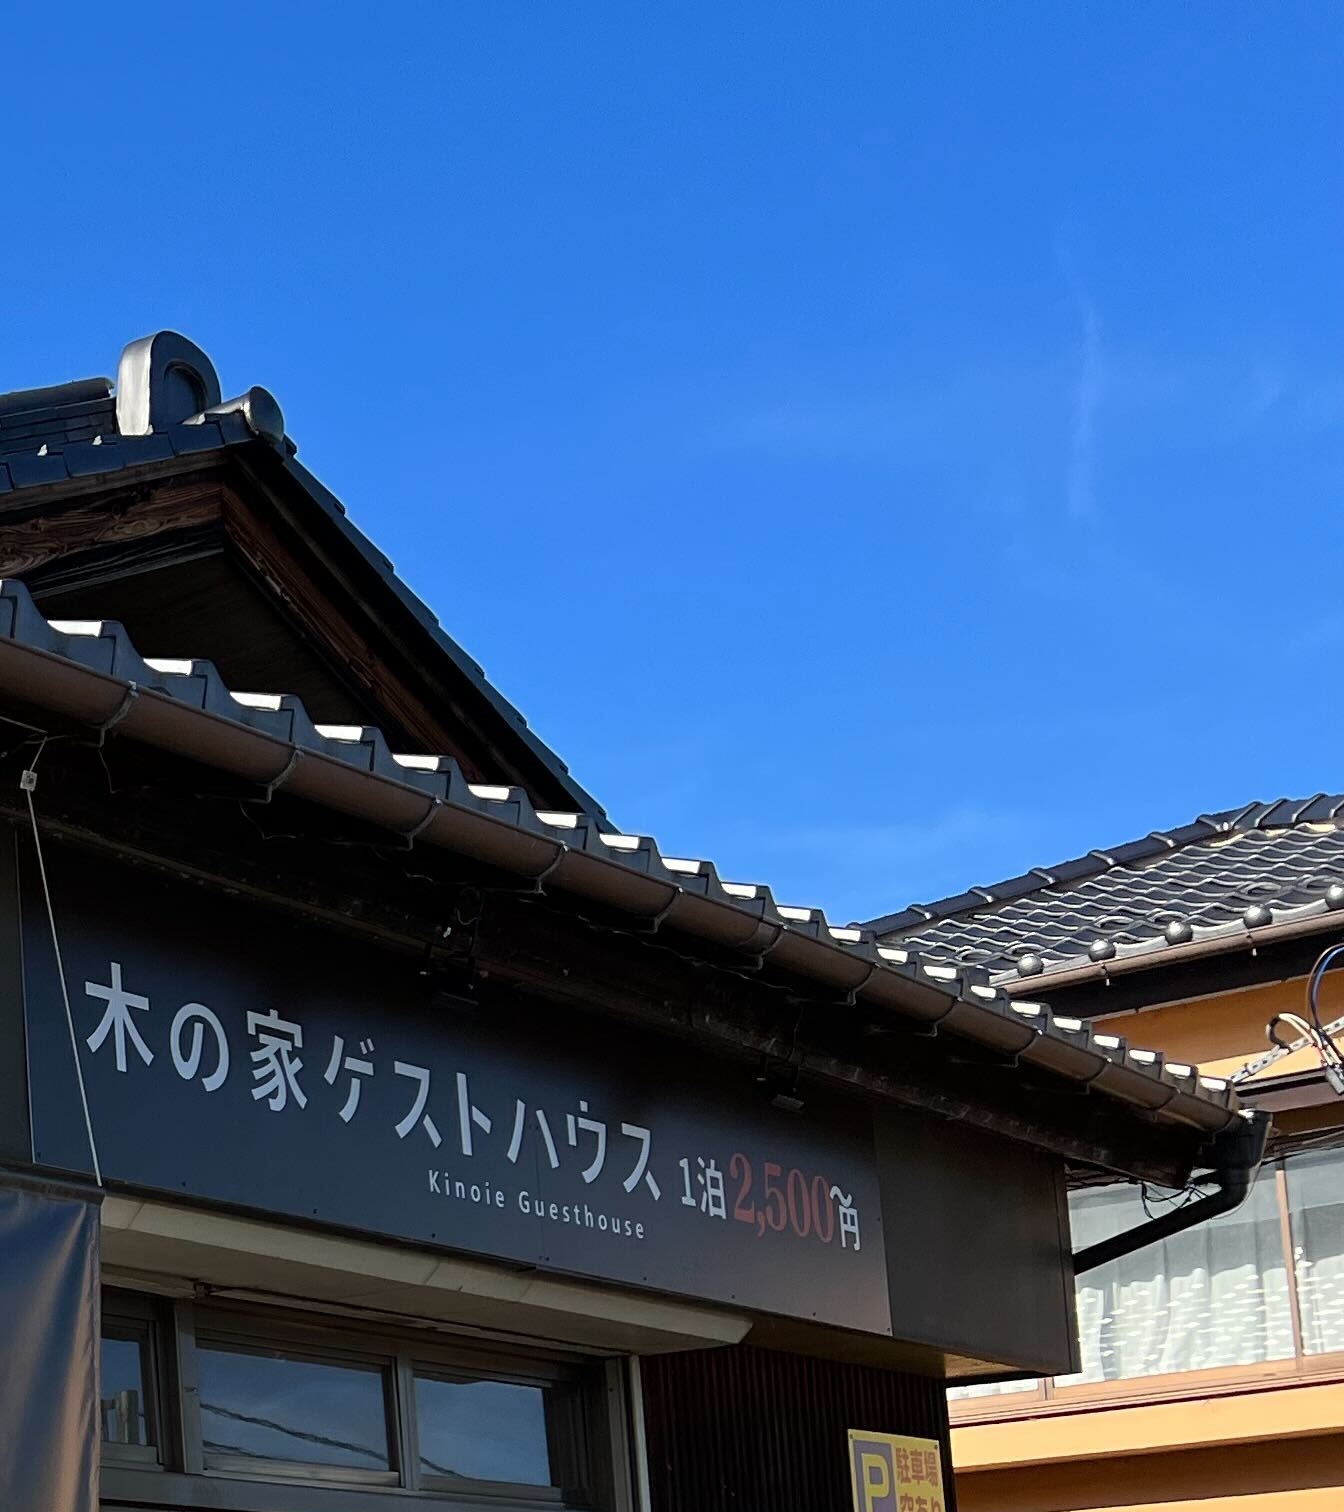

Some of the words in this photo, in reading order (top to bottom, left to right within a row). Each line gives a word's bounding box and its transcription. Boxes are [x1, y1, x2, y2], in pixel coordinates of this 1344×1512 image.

[85, 962, 661, 1201] 木の家ゲストハウス
[428, 1169, 506, 1208] Kinoie
[519, 1191, 646, 1239] Guesthouse
[896, 1448, 939, 1487] 駐車場
